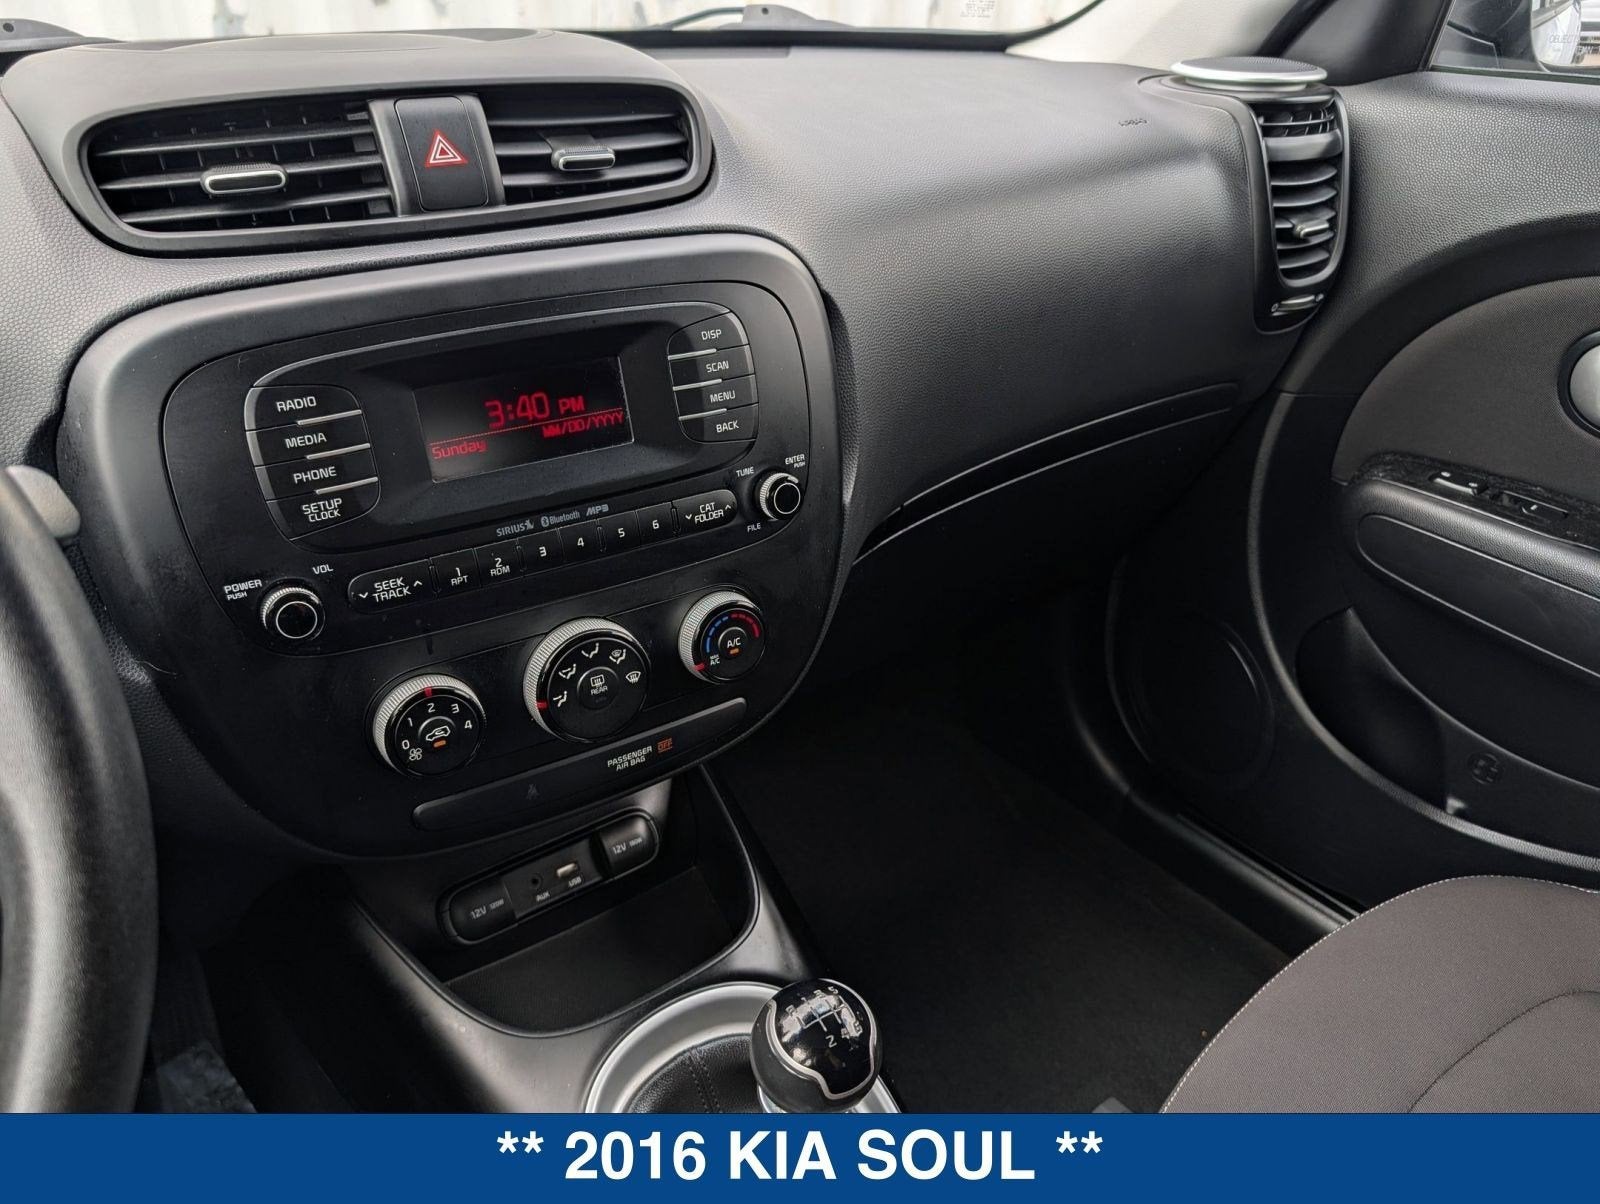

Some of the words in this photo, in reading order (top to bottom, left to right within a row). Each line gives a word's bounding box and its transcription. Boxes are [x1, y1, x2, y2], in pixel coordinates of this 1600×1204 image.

[701, 329, 722, 340] DISP
[706, 360, 729, 373] SCAN
[710, 390, 736, 403] MENU
[276, 396, 317, 412] RADIO
[485, 392, 550, 428] 3:40
[558, 395, 585, 414] PM
[543, 411, 624, 438] MM/DD/YYYY
[716, 420, 740, 433] BACK
[285, 432, 327, 449] MEDIA
[431, 440, 488, 460] Sunday
[785, 454, 805, 466] ENTER
[293, 466, 337, 484] PHONE
[736, 466, 754, 478] TUNE
[302, 498, 343, 514] SETUP
[700, 502, 716, 513] CAT
[308, 509, 341, 522] CLOCK
[550, 510, 580, 525] Bluetooth
[586, 504, 609, 516] MP3
[694, 509, 724, 524] FOLDER
[652, 519, 660, 529] 6
[747, 523, 761, 532] FILE
[618, 528, 626, 538] 5
[577, 537, 585, 547] 4
[539, 546, 547, 557] 3
[312, 564, 333, 574] VOL
[494, 558, 502, 568] 2
[455, 567, 461, 576] 1
[490, 566, 510, 577] RDM
[223, 579, 262, 593] POWER
[374, 577, 405, 592] SEEK
[451, 575, 468, 586] RPT
[227, 592, 247, 600] PUSH
[372, 586, 411, 602] TRACK
[727, 637, 741, 648] A/C
[590, 685, 608, 695] REAR
[427, 703, 435, 713] 2
[451, 704, 460, 714] 3
[407, 717, 413, 727] 1
[464, 720, 472, 729] 4
[402, 740, 410, 749] 0
[607, 745, 652, 767] PASSENGER
[616, 761, 629, 771] AIR
[630, 756, 646, 766] BAG
[612, 841, 627, 855] 12V
[471, 905, 487, 919] 12V
[825, 1035, 837, 1048] 2
